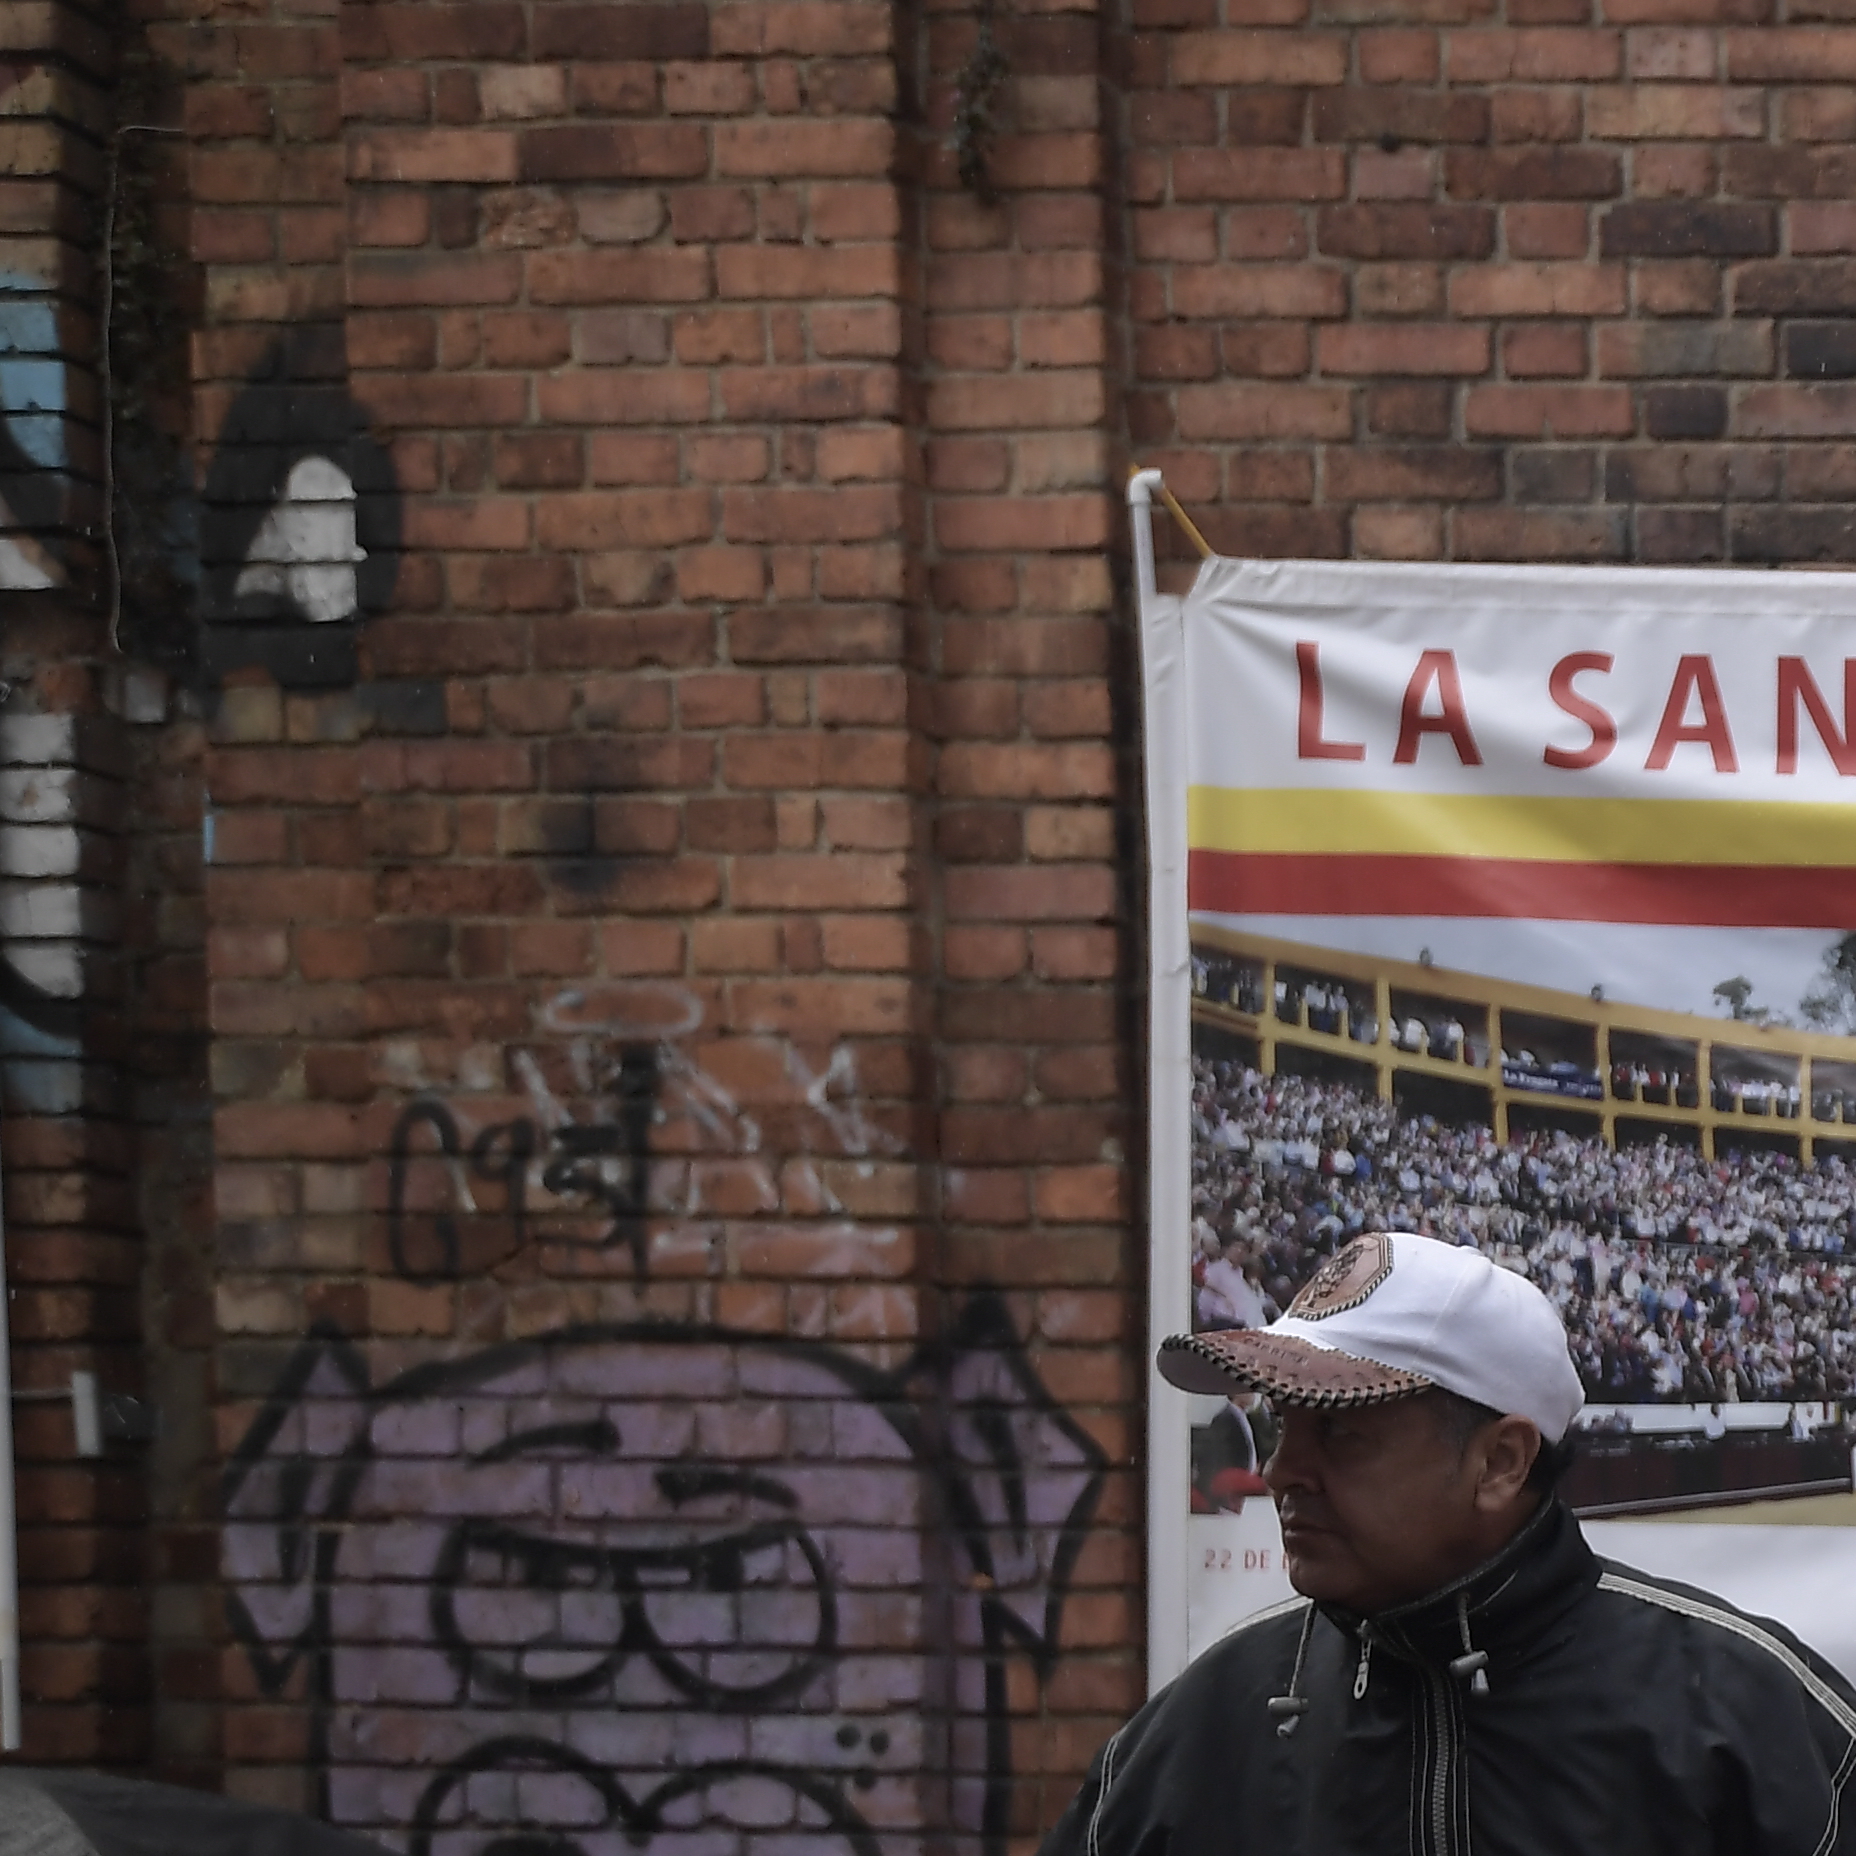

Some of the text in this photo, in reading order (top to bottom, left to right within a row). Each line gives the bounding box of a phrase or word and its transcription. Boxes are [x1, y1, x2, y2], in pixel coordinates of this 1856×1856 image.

[1295, 640, 1483, 767] LA
[1204, 1549, 1233, 1570] 22
[1243, 1549, 1271, 1570] DE
